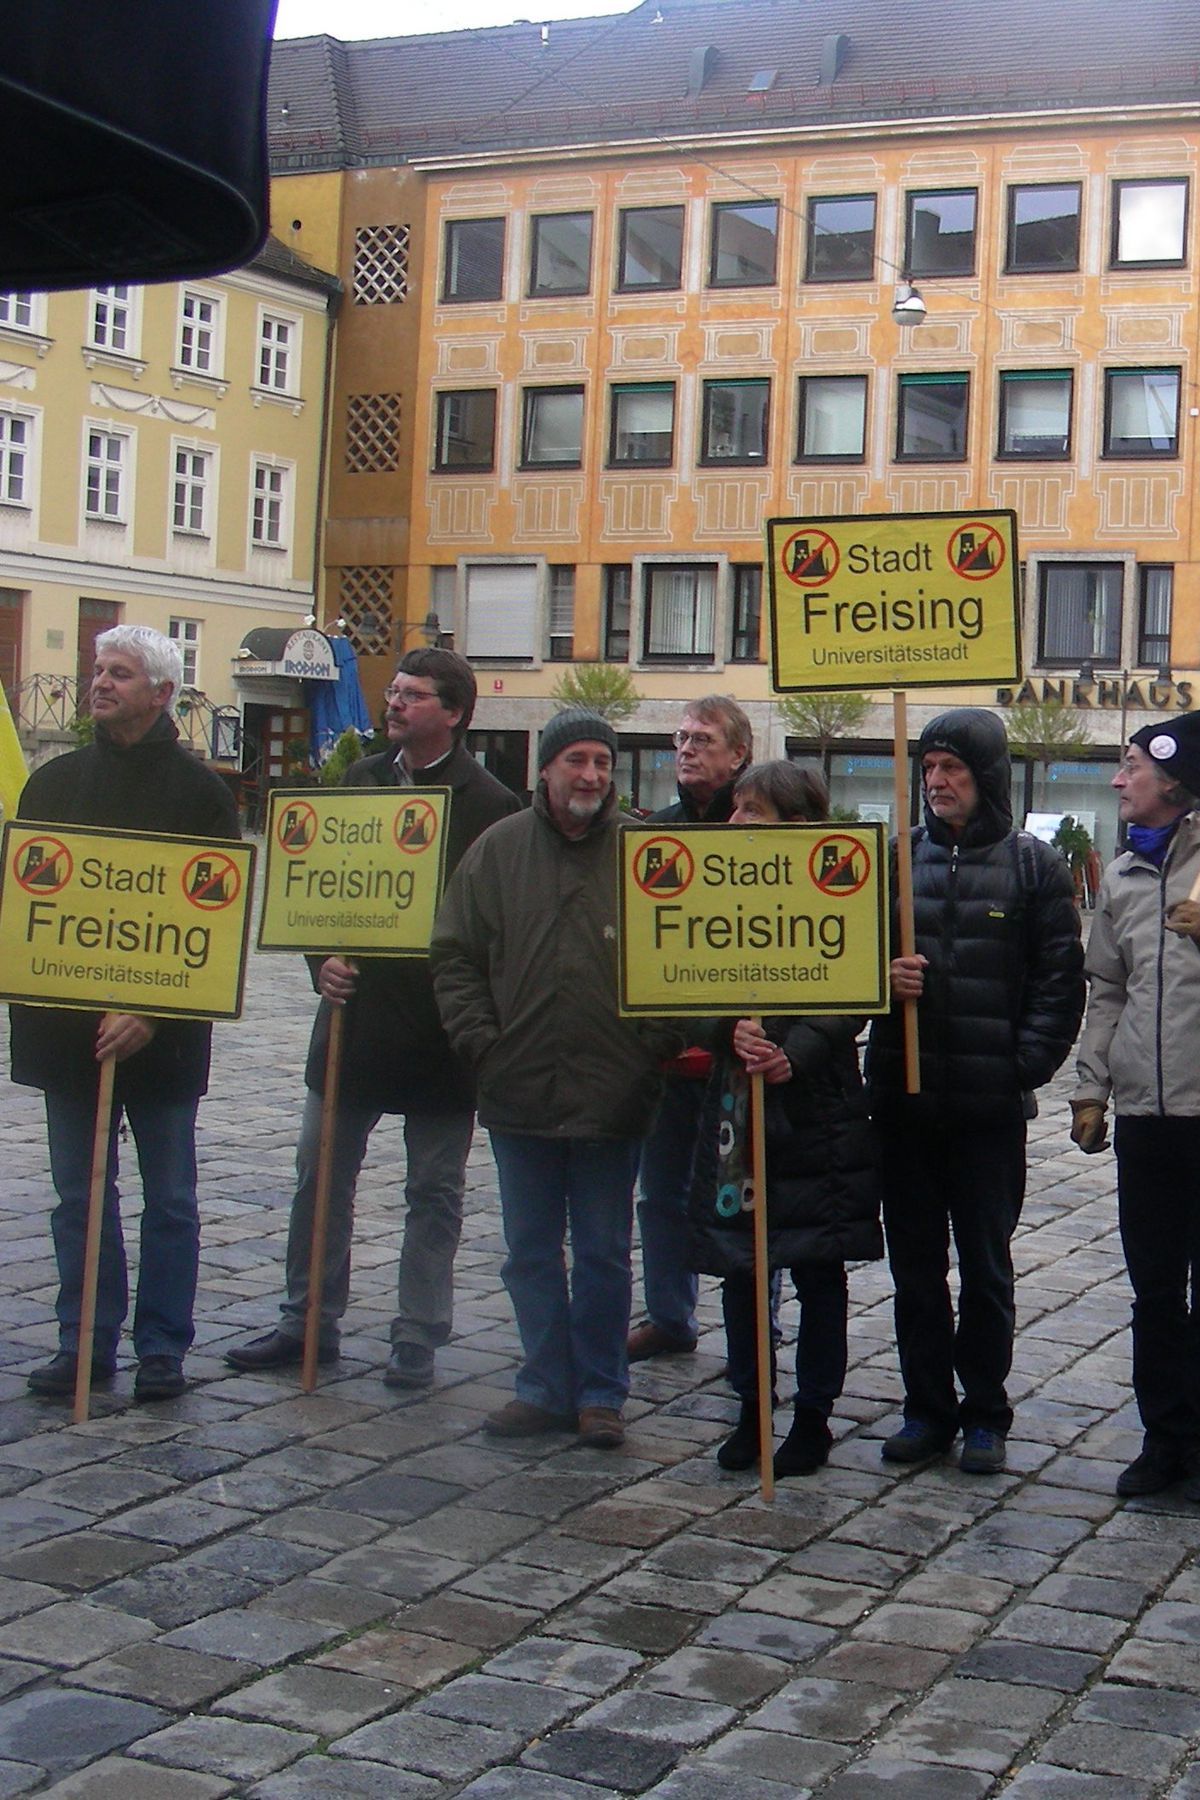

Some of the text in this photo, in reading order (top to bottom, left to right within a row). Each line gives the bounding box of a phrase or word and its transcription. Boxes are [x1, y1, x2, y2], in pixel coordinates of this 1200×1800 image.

[847, 541, 933, 574] Stadt
[803, 588, 984, 640] Freising
[284, 660, 330, 677] IRODION
[812, 643, 969, 666] Universitätsstadt
[997, 678, 1193, 709] BANKHAUS
[322, 816, 382, 844] Stadt
[80, 858, 167, 895] Stadt
[286, 860, 415, 910] Freising
[703, 854, 792, 887] Stadt
[27, 900, 211, 969] Freising
[287, 911, 399, 929] Universitätsstadt
[655, 904, 845, 960] Freising
[31, 957, 190, 988] Universitätsstadt
[663, 963, 829, 984] Universitätsstadt
